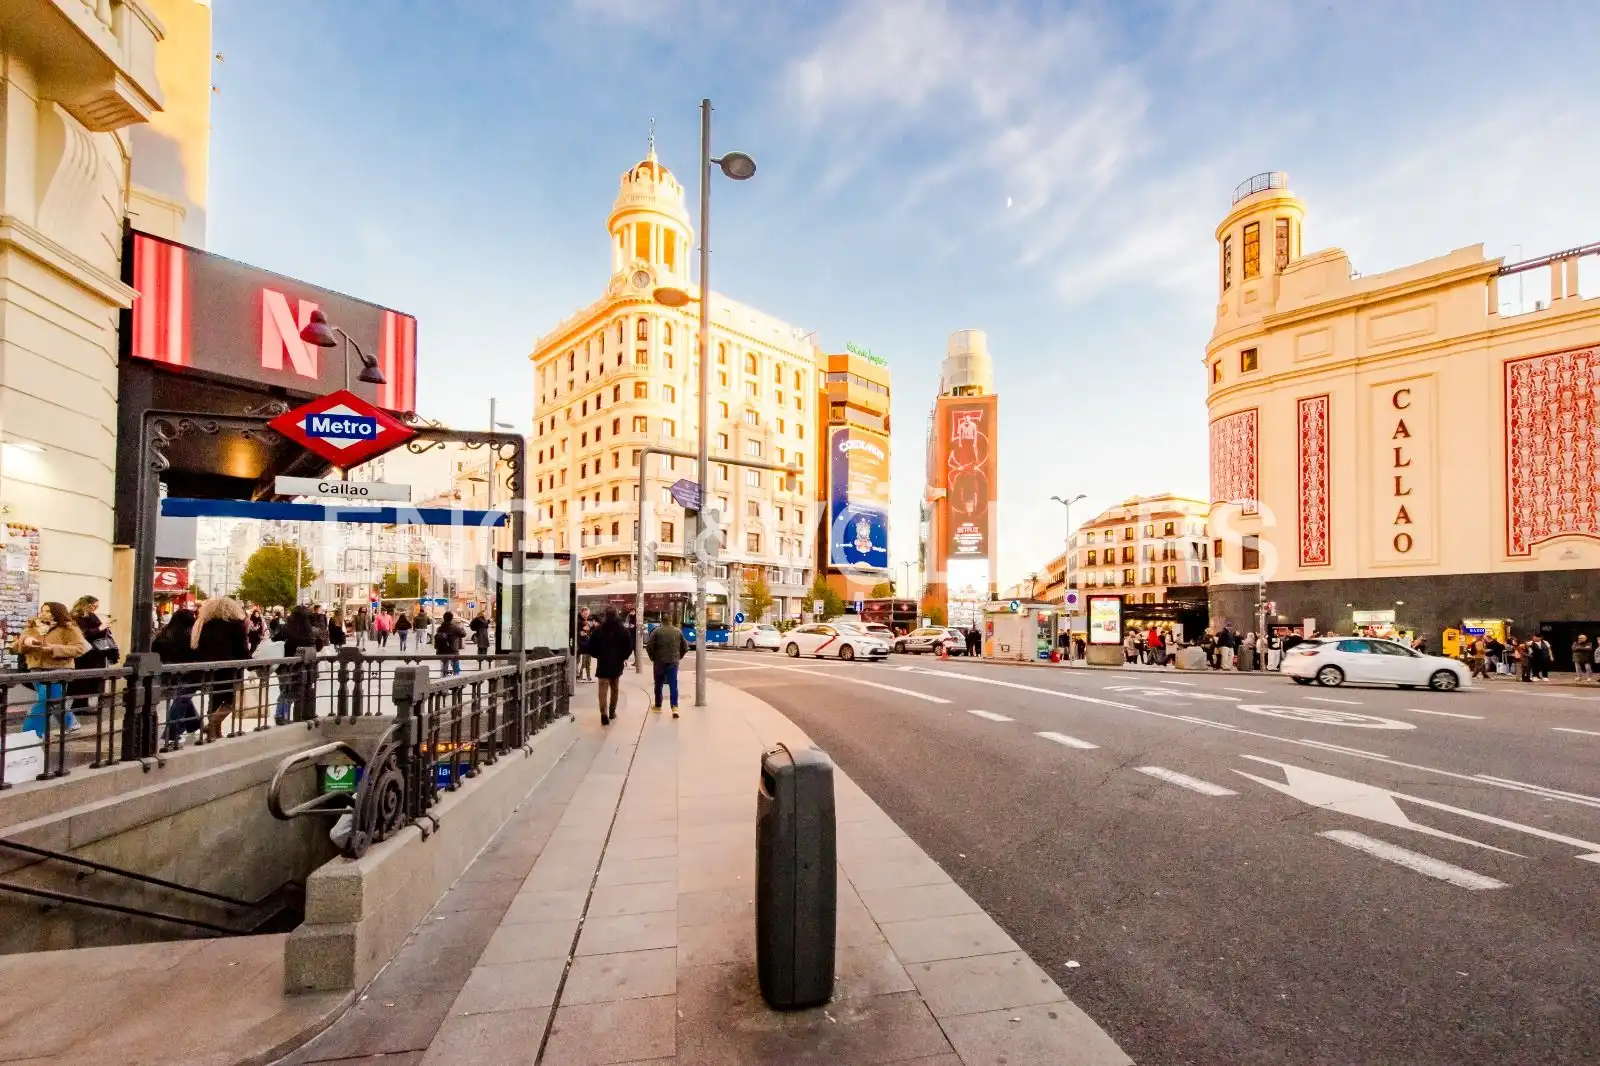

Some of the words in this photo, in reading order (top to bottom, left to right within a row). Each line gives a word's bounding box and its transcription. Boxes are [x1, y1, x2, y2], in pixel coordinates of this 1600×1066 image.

[262, 288, 318, 380] N
[312, 416, 372, 435] Metro
[318, 482, 368, 496] Callao
[1392, 388, 1413, 553] CALLAO
